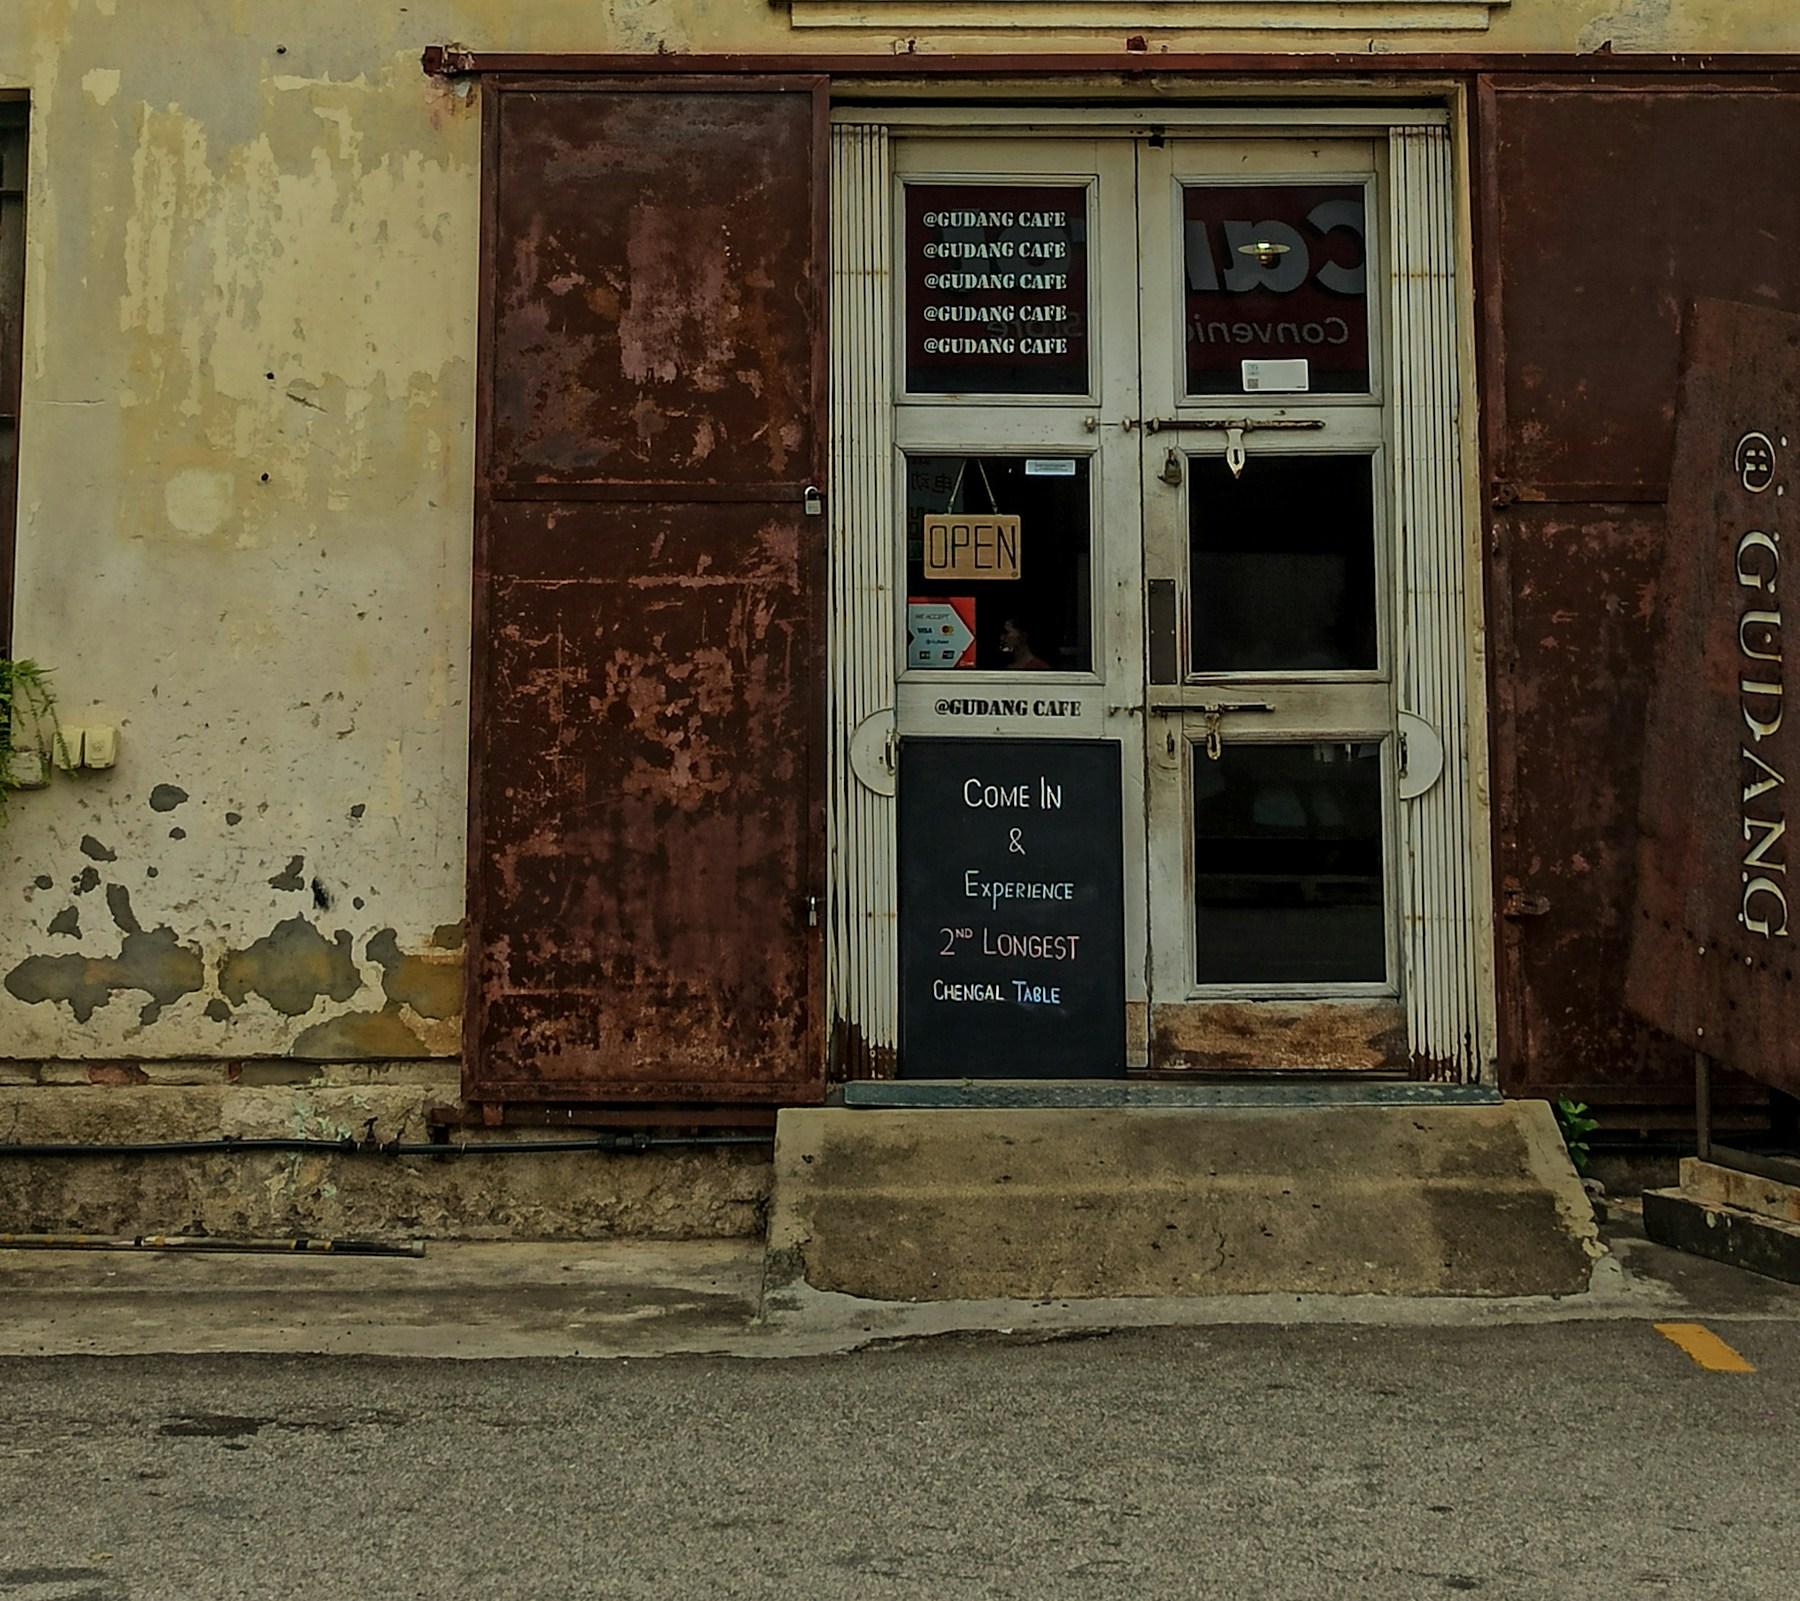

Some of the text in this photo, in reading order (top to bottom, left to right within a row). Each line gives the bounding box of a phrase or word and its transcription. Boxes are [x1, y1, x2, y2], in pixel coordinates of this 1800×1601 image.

[923, 212, 1066, 228] @GUDANG CAFE
[923, 242, 1066, 259] @GUDANG CAFE
[924, 273, 1067, 290] @GUDANG CAFE
[924, 305, 1067, 322] @GUDANG CAFE
[924, 338, 1067, 354] @GUDANG CAFE
[929, 525, 1017, 569] OPEN
[934, 699, 1082, 717] @GUDANG CAFE
[1736, 529, 1789, 940] GUDANG
[1008, 827, 1026, 855] &
